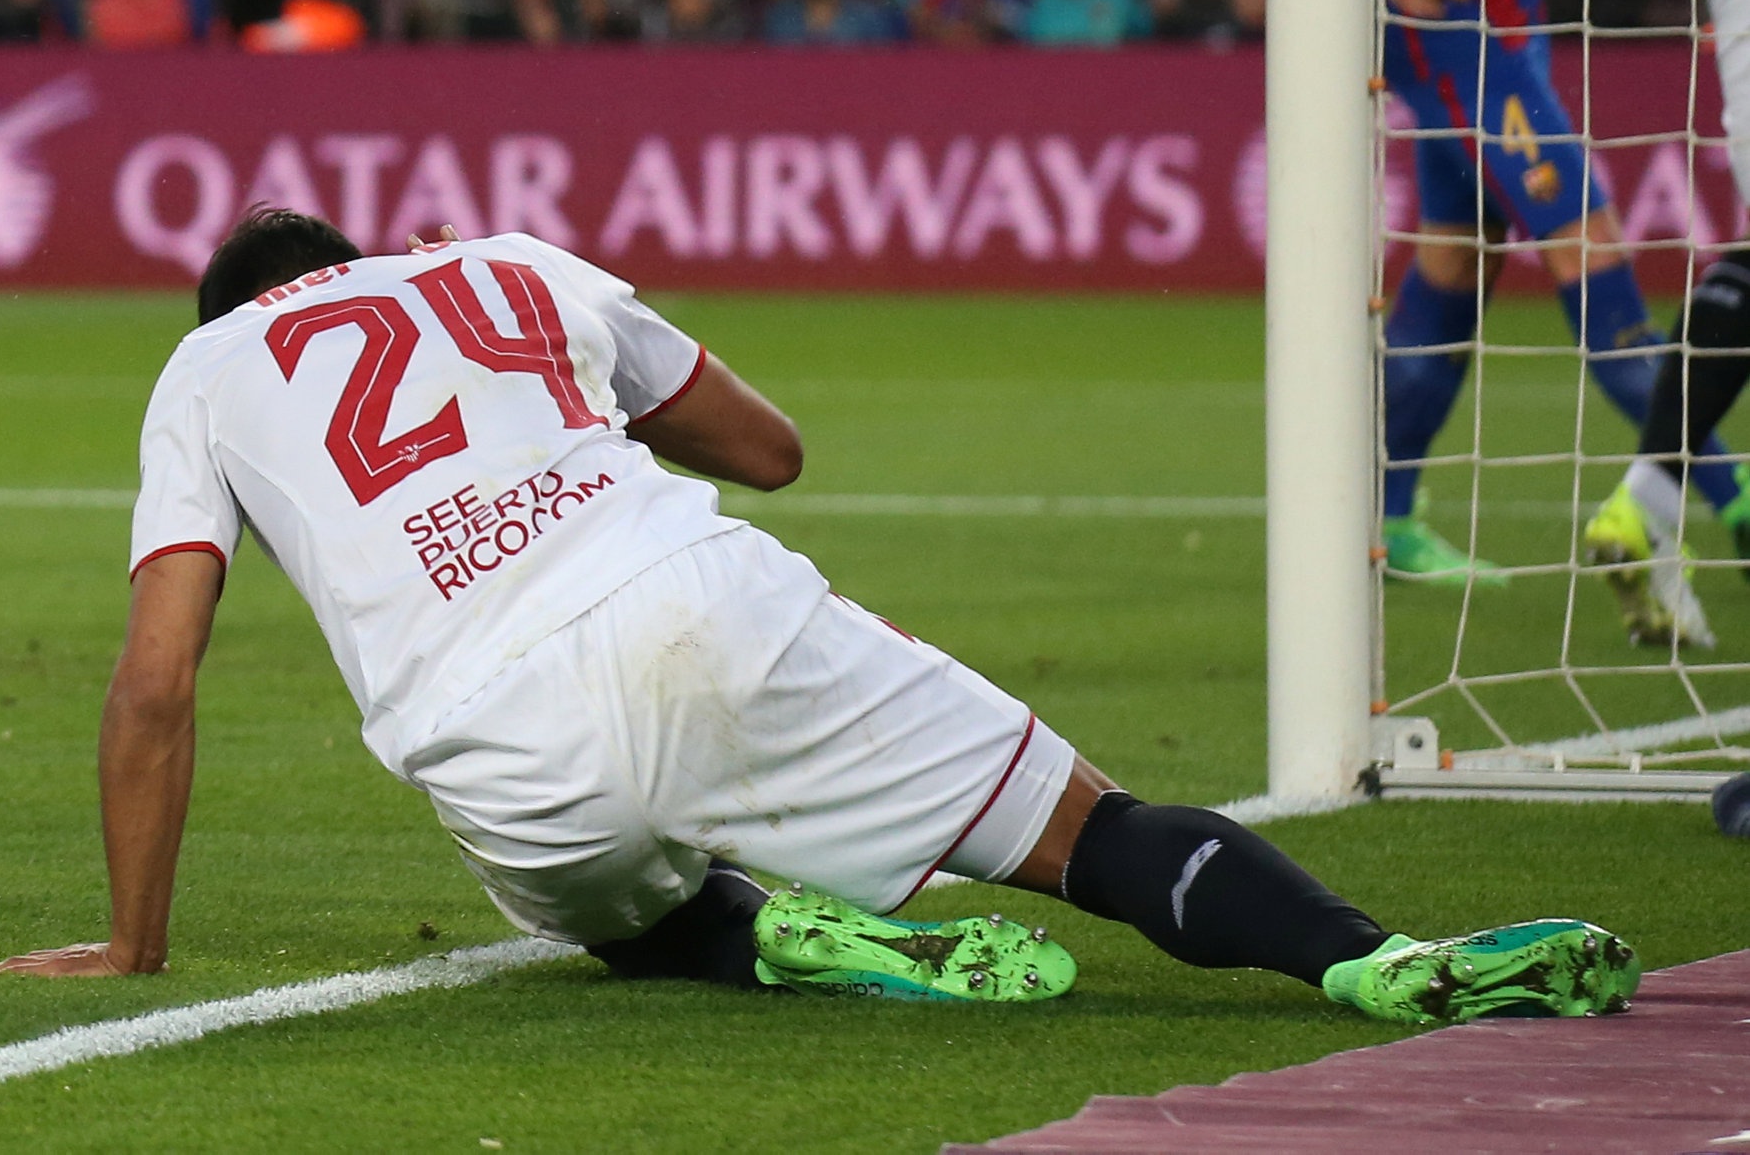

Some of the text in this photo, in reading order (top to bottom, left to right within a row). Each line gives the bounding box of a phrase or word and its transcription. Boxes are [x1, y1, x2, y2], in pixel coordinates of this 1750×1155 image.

[1502, 95, 1540, 163] 4
[114, 133, 578, 278] QATAR
[600, 135, 1204, 262] AIRWAYS
[264, 258, 610, 506] 24
[403, 483, 486, 546] SEE
[417, 470, 564, 571] PUERTO
